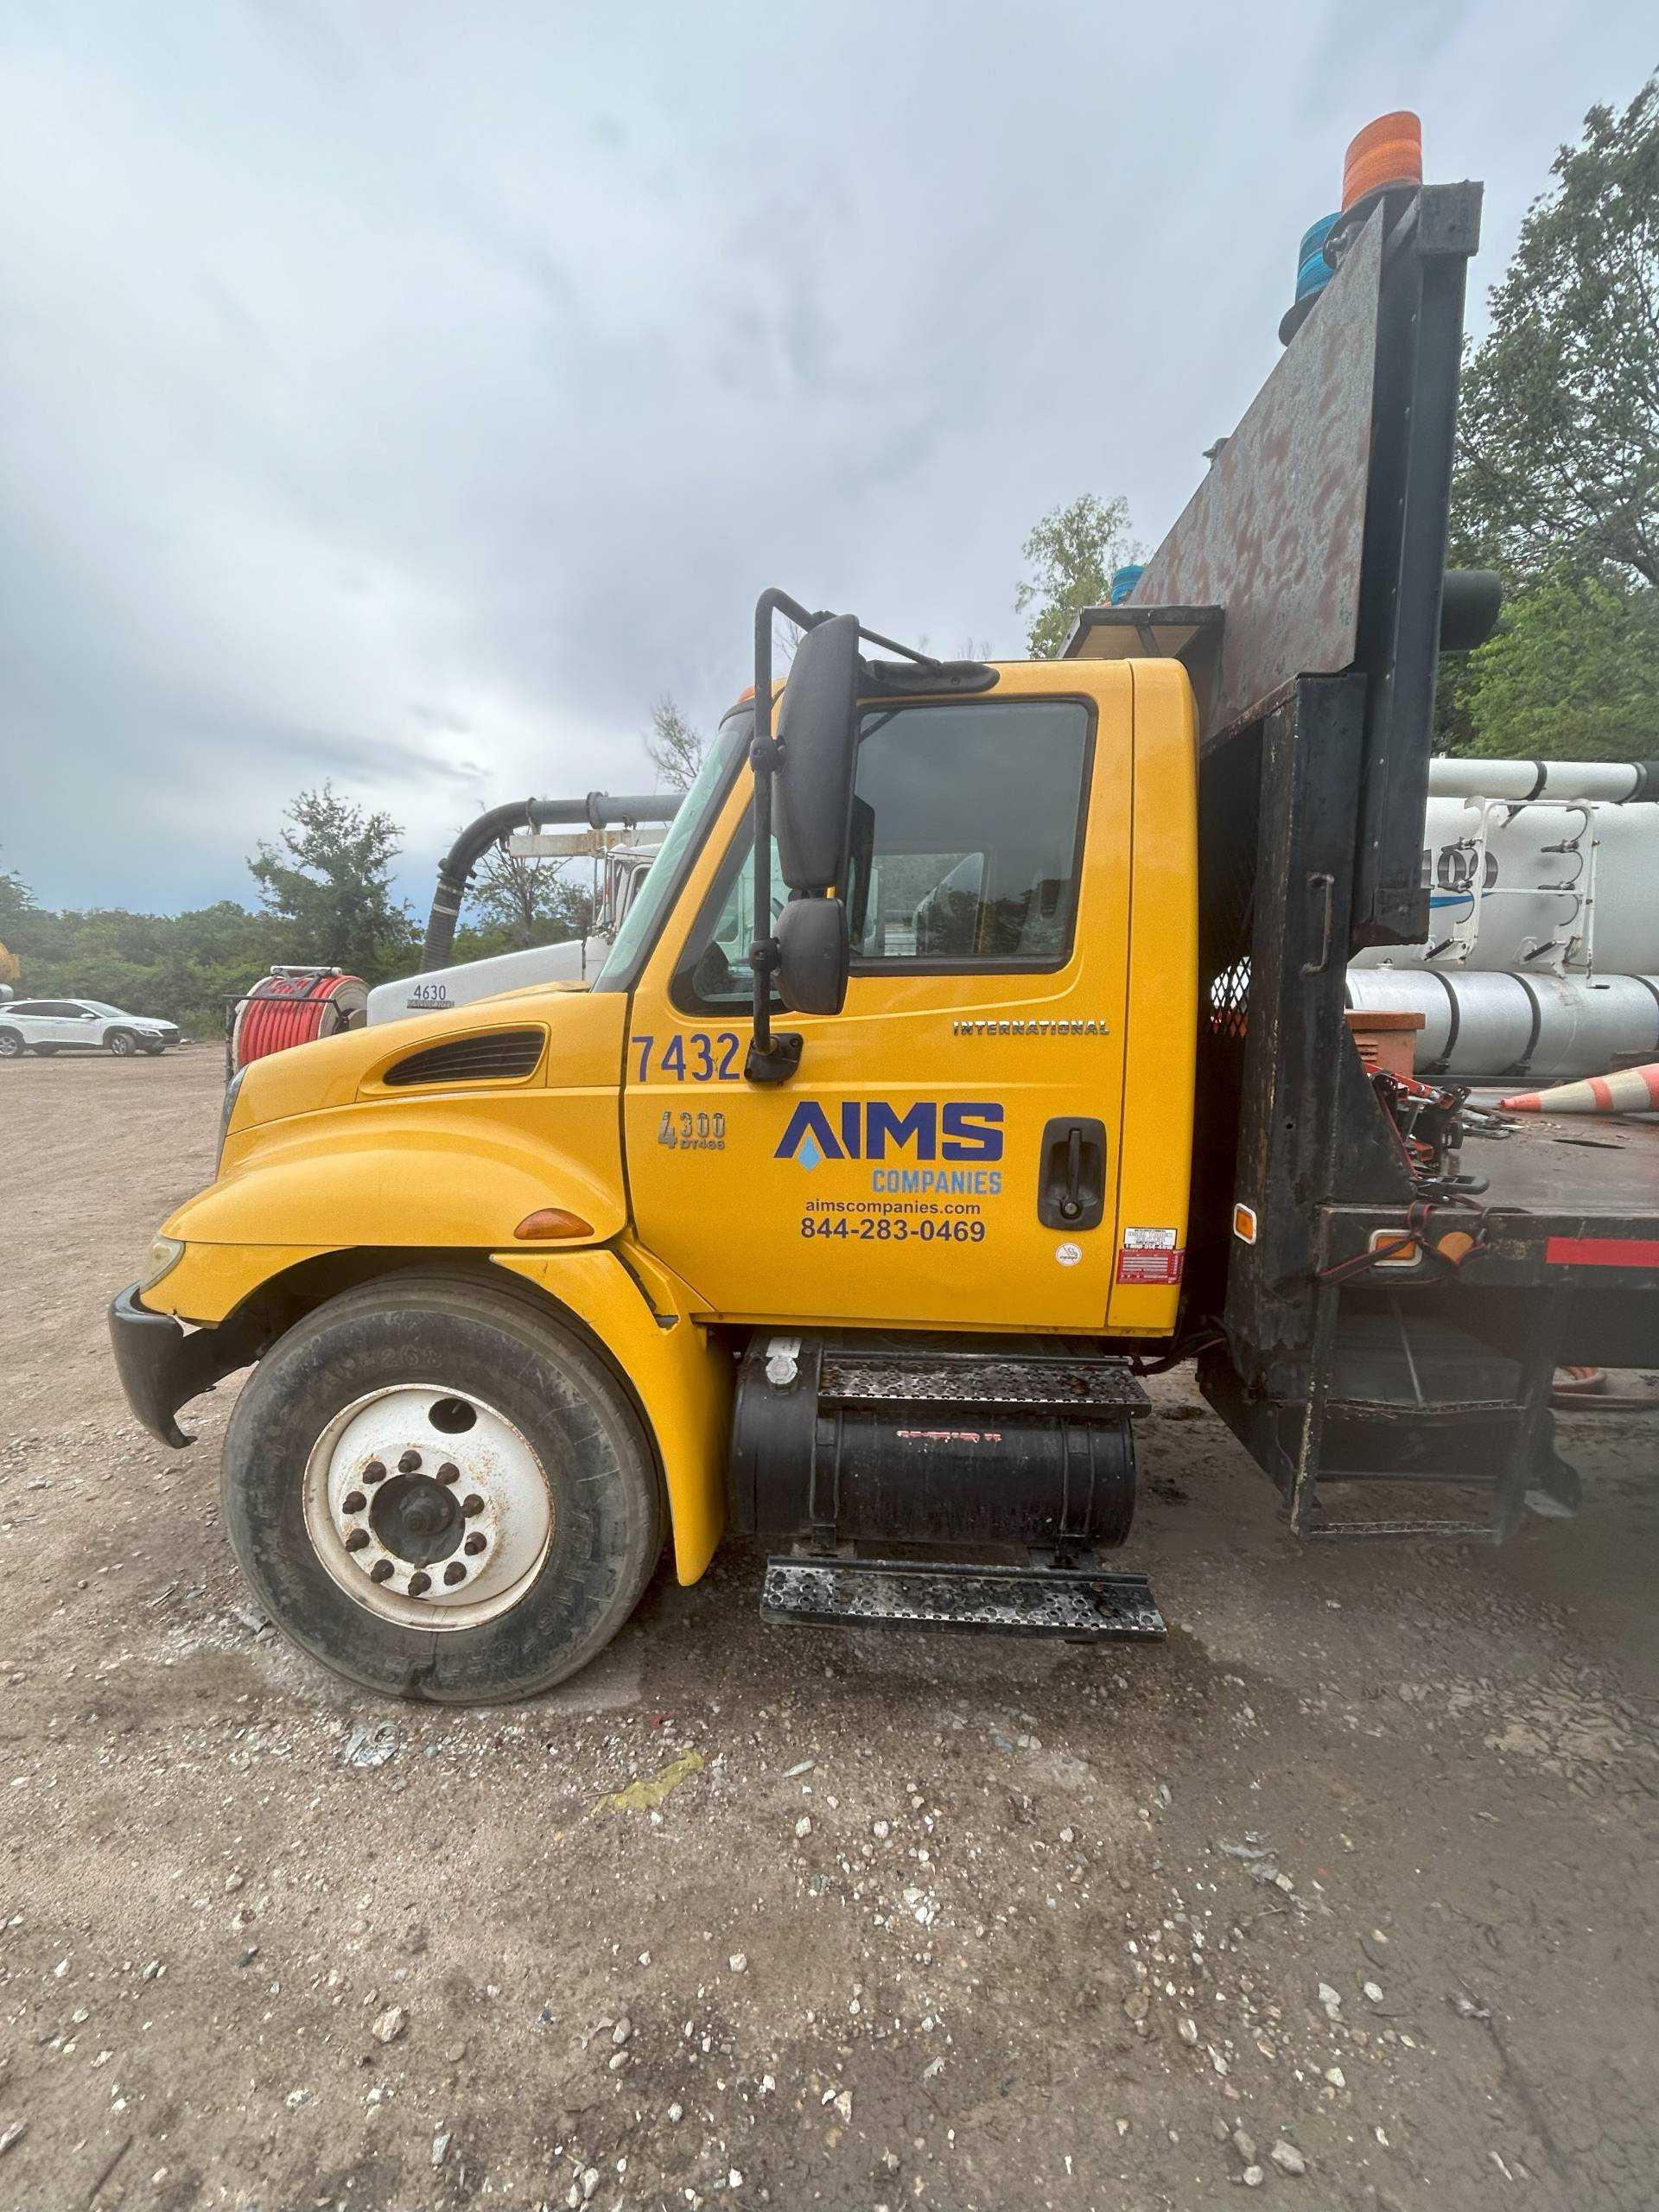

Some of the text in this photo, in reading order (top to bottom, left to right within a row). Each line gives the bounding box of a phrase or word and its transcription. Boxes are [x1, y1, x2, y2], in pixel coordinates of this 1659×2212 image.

[414, 984, 446, 1000] 4630
[953, 1020, 1110, 1036] INTERNATIONAL
[632, 1033, 741, 1082] 7432
[658, 1111, 726, 1148] 4300
[773, 1101, 1004, 1161] AIMS
[872, 1167, 1003, 1195] COMPANIES
[805, 1198, 981, 1215] aimscompanies.com
[800, 1217, 986, 1242] 844-283-0469
